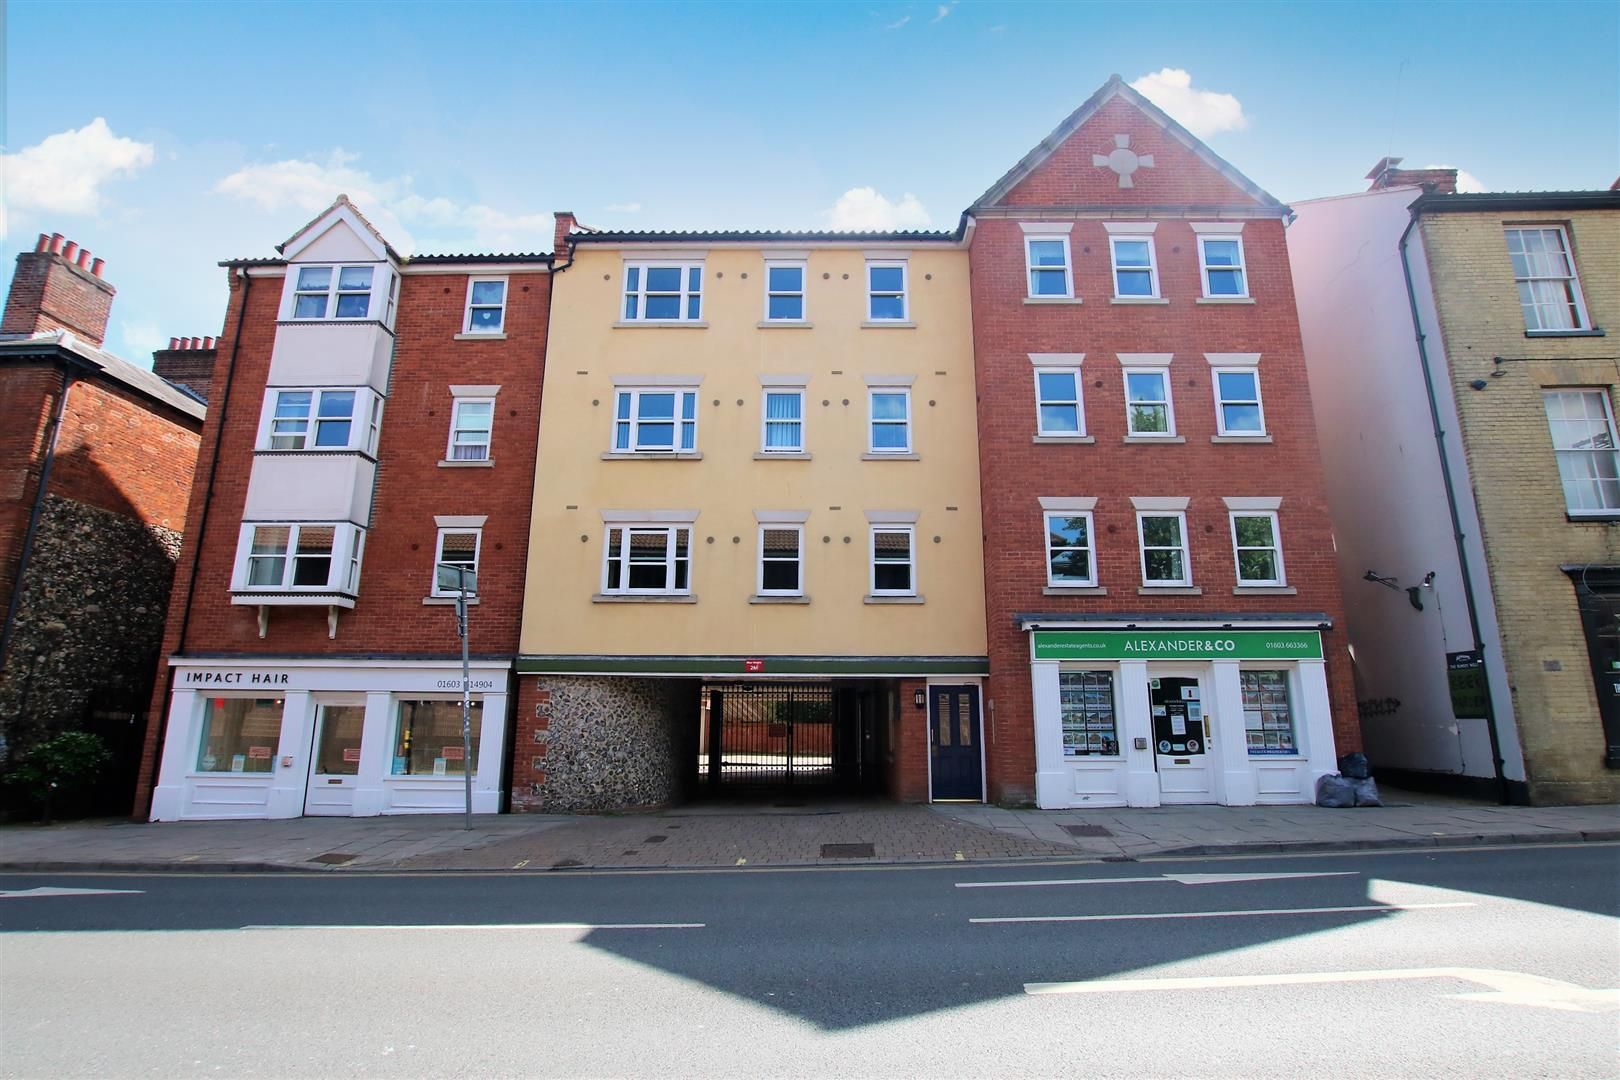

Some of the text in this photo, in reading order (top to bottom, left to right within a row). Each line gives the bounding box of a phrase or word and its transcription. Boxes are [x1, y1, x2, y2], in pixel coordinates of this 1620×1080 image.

[1124, 640, 1235, 651] ALEXANDER&CO
[186, 672, 289, 684] IMPACT HAIR
[437, 680, 493, 689] 01603 14904
